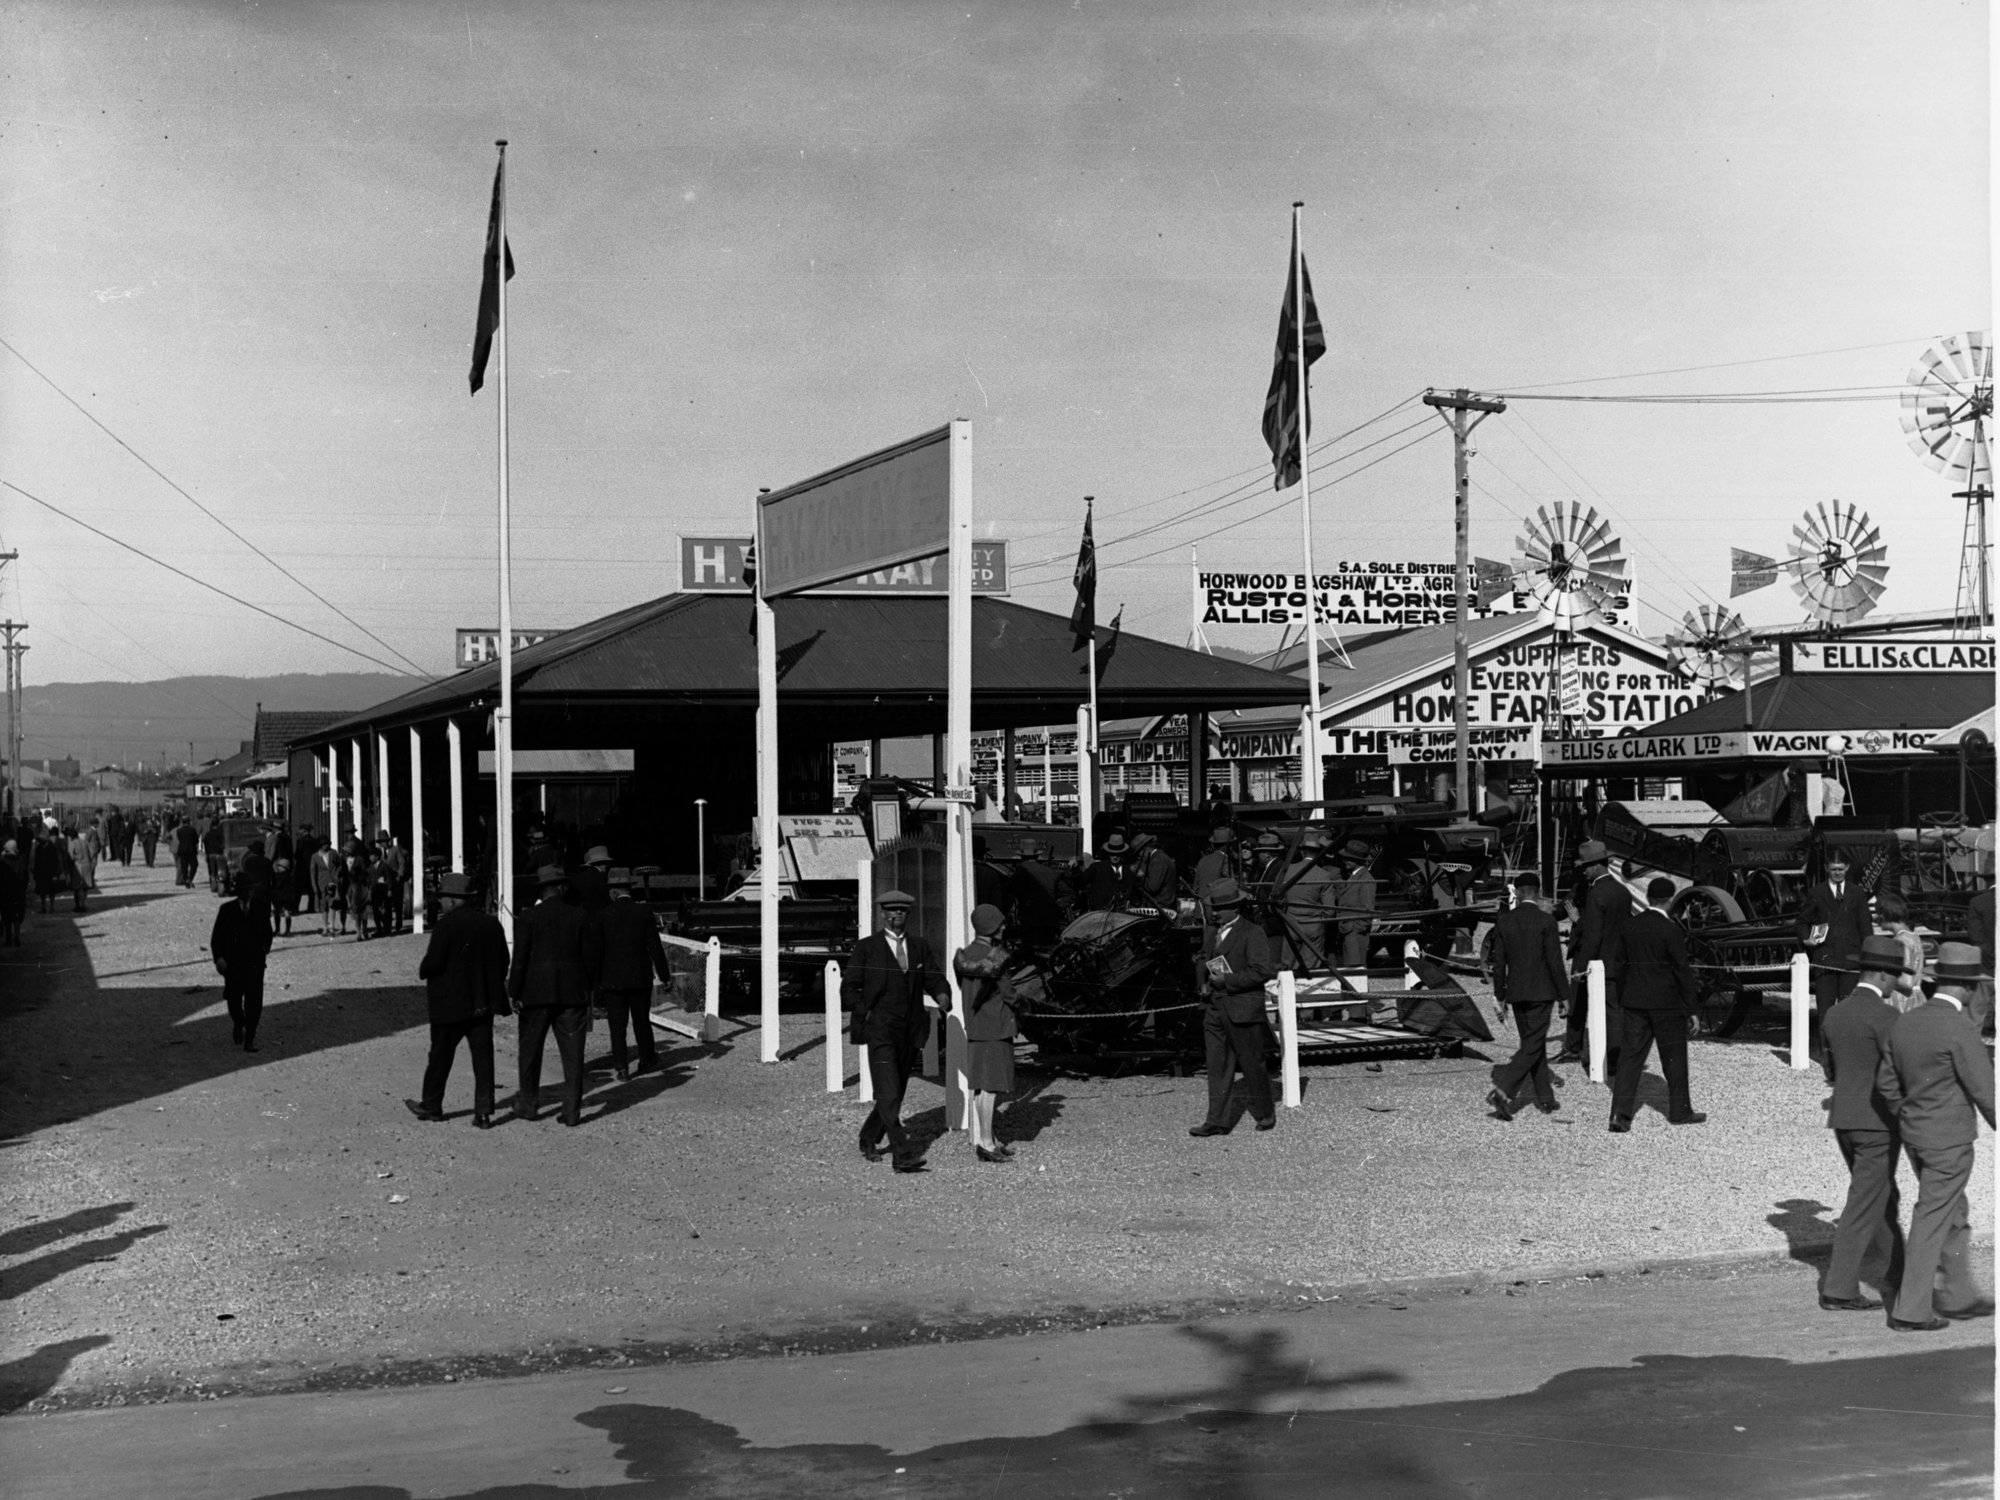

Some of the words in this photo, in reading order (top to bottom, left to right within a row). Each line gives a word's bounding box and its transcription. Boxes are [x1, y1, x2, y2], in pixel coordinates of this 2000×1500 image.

[972, 549, 995, 562] TY
[972, 568, 994, 581] TD
[1339, 562, 1366, 573] S.A.
[1369, 562, 1404, 574] SOLE
[1200, 573, 1287, 589] HORWOOD
[1207, 589, 1328, 607] RUSTON
[1338, 594, 1356, 607] &
[1364, 590, 1480, 608] HORNSB
[1497, 645, 1621, 667] SUPPERS
[1441, 673, 1456, 690] O
[1471, 666, 1610, 690] EVERYTNG
[1616, 674, 1651, 690] FOR
[1656, 674, 1691, 690] THE
[1393, 693, 1479, 723] HOME
[1158, 726, 1188, 735] ARMERS
[1169, 717, 1188, 726] YEA
[1328, 729, 1390, 753] THE
[1390, 735, 1424, 748] THE
[1428, 728, 1531, 747] IMPEMENT
[1752, 734, 1853, 751] WAGNR
[1892, 732, 1938, 749] MOT
[1100, 743, 1126, 764] THE
[1130, 740, 1200, 764] IMPLEME
[1218, 733, 1301, 759] COMPANY.
[1561, 742, 1604, 761] ELLIS
[1606, 743, 1618, 759] &
[1622, 737, 1686, 759] CLARK
[1694, 735, 1721, 755] LTD
